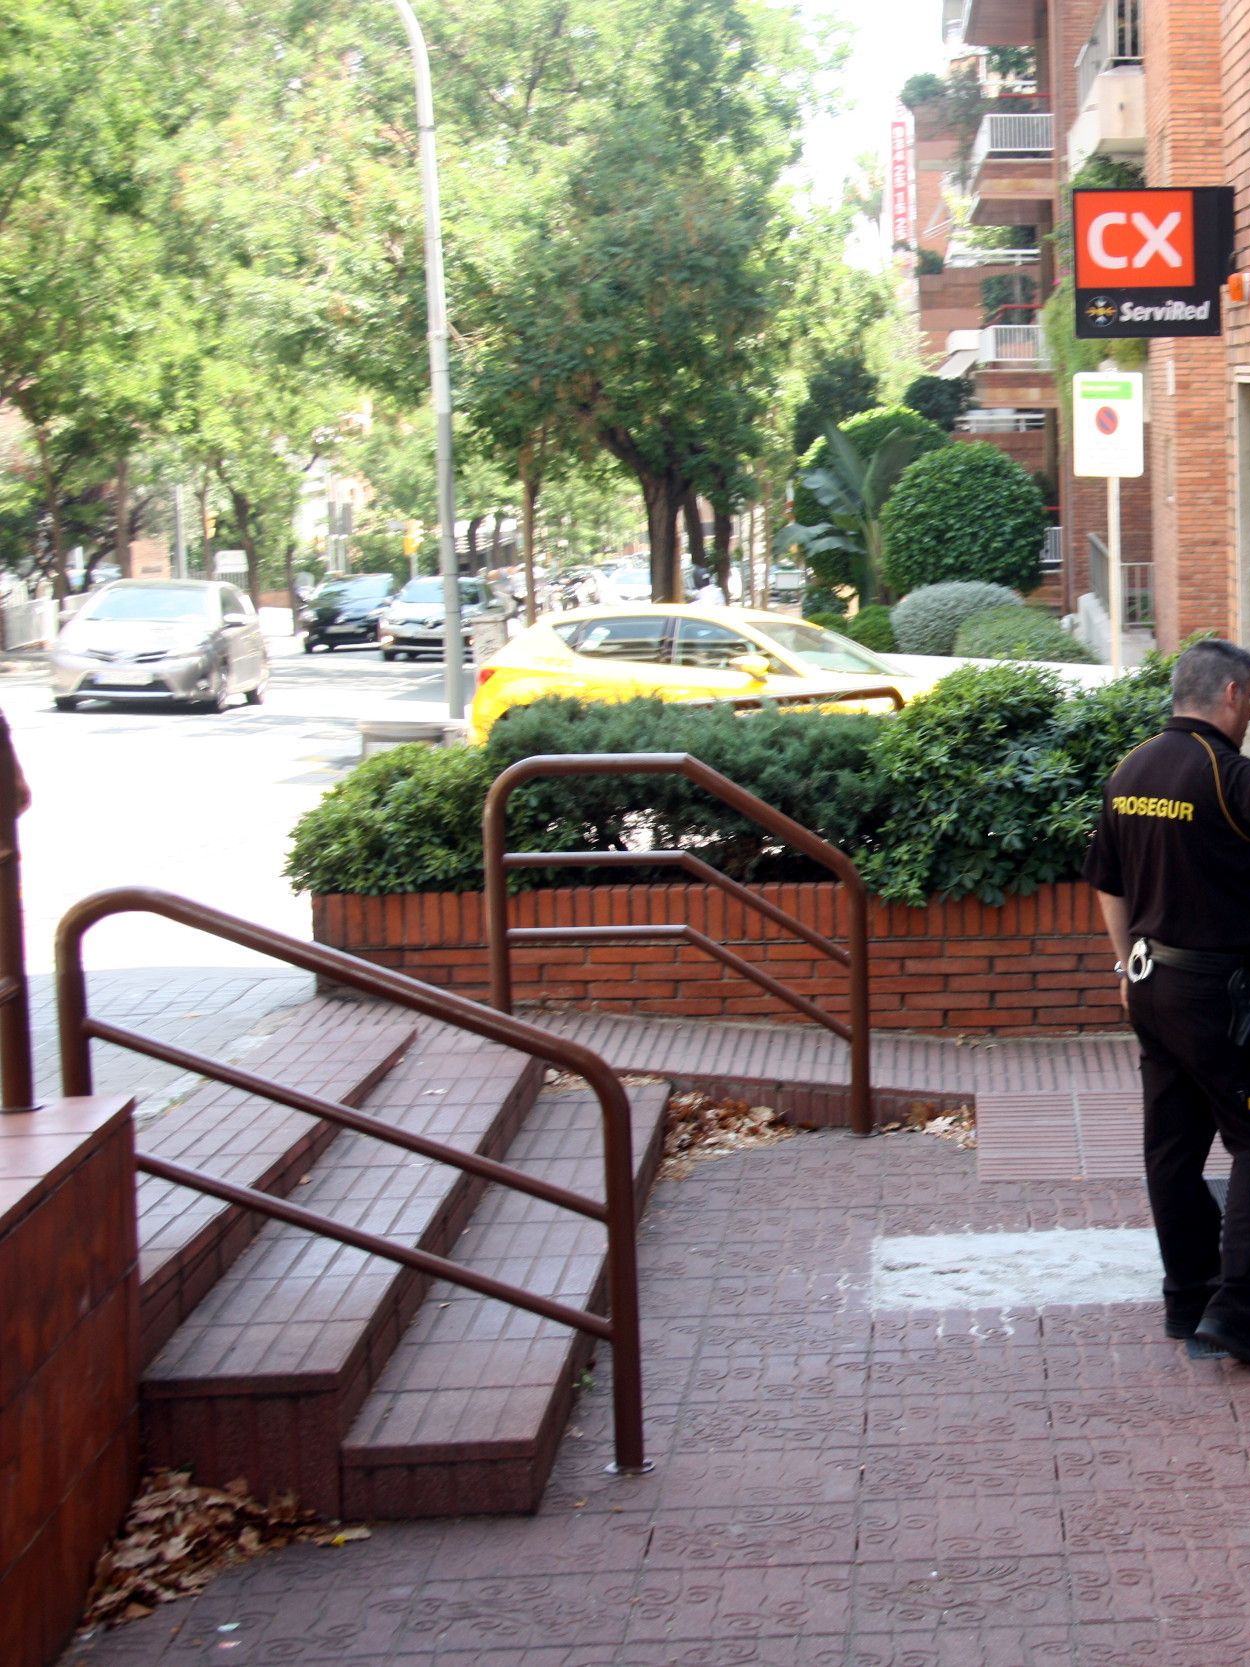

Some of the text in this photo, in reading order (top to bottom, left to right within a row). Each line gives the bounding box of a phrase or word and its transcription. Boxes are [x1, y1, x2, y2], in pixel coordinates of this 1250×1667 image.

[1086, 211, 1183, 269] CX
[1118, 299, 1211, 322] ServiRed
[1112, 796, 1194, 821] PROSEGUR
